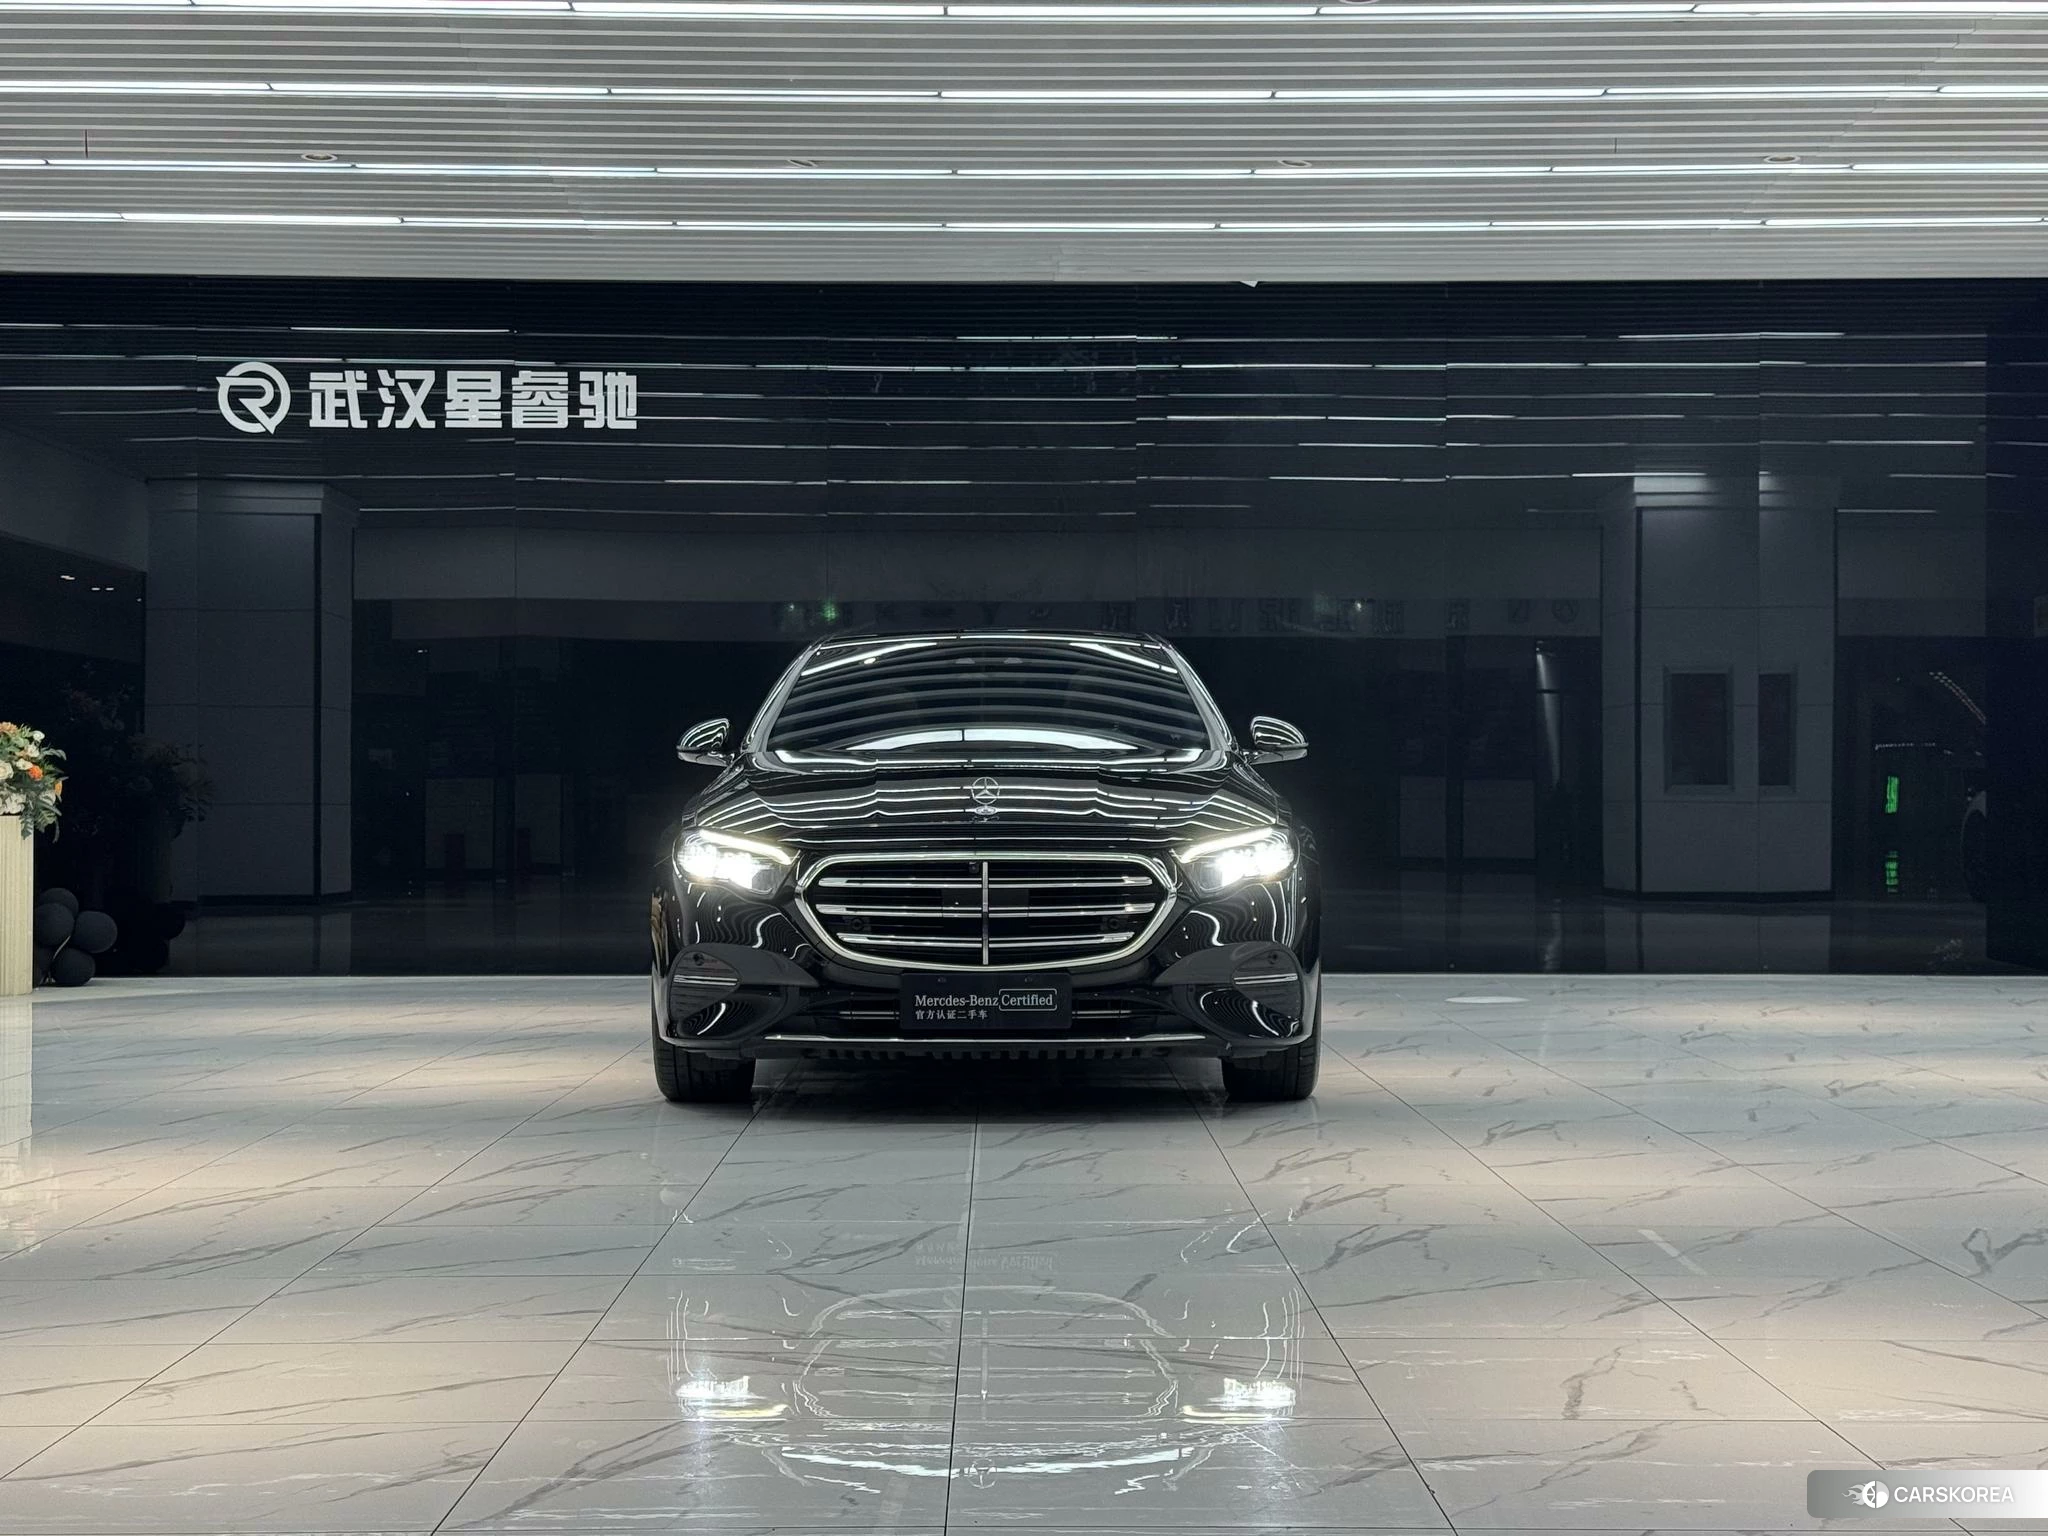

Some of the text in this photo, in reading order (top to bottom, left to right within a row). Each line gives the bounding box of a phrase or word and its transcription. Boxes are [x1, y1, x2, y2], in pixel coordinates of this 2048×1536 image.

[308, 370, 638, 429] 武汉星睿驰
[1001, 994, 1053, 1006] Certified
[915, 1010, 988, 1020] 官方认证二手车
